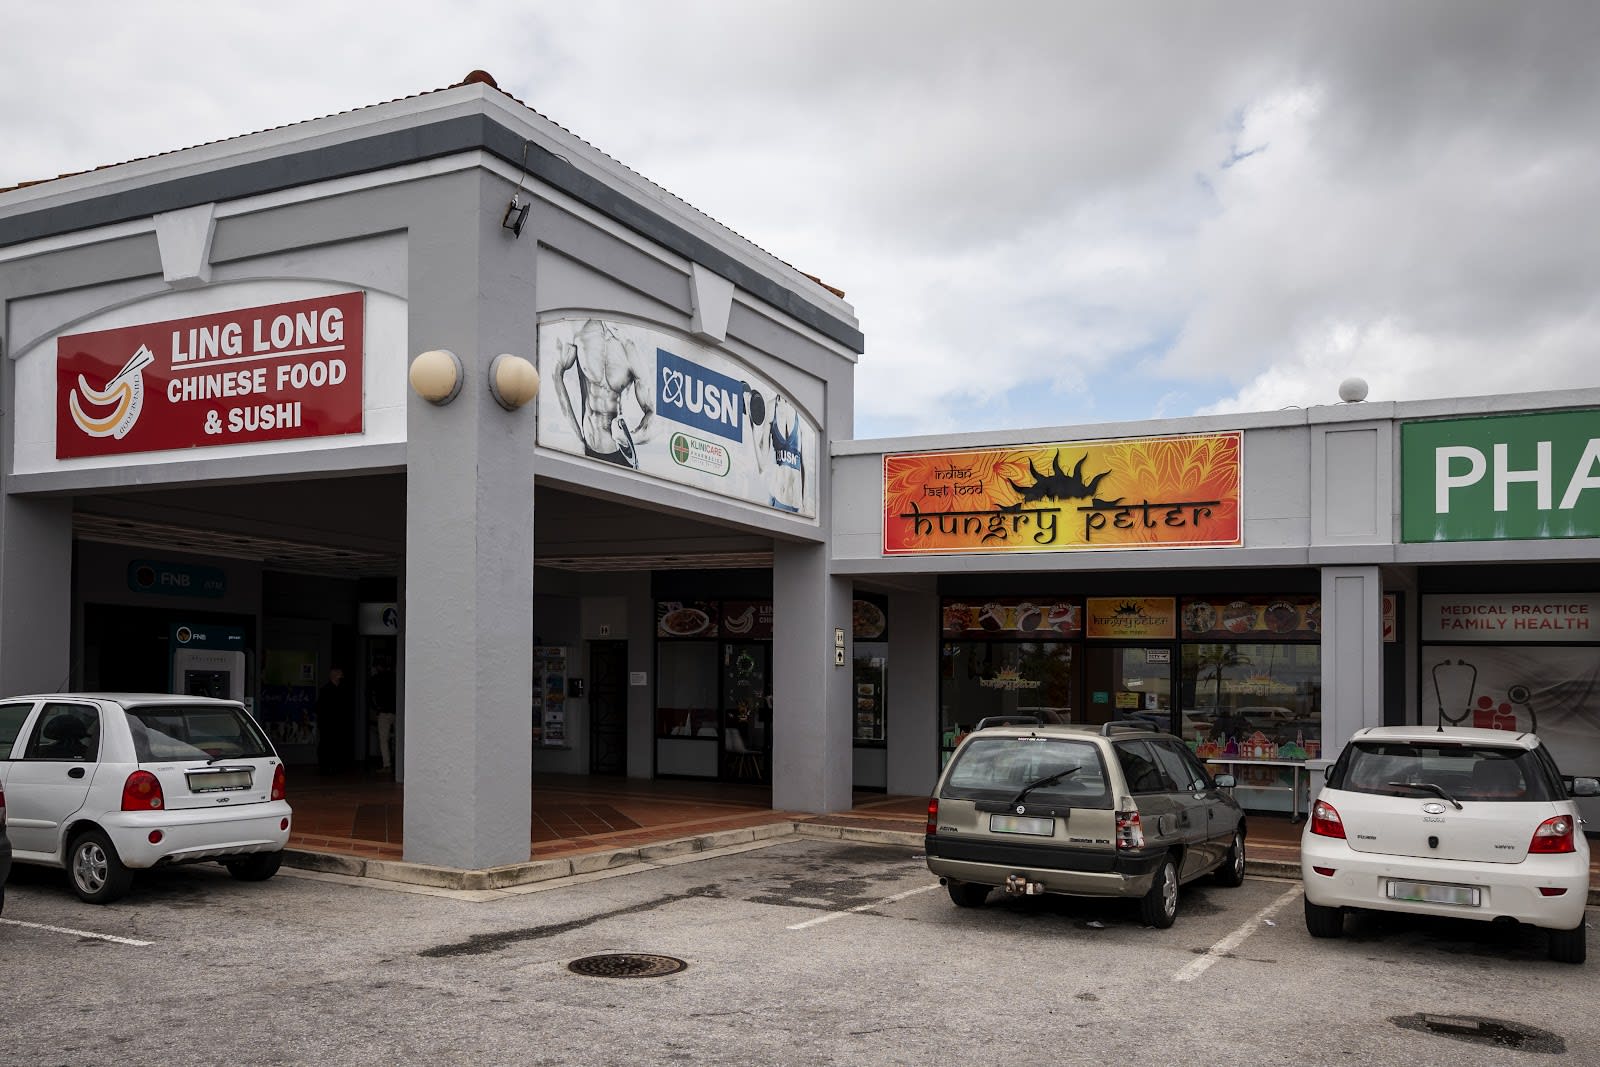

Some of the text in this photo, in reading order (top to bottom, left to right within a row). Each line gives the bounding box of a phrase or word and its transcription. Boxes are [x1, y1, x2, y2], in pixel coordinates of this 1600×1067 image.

[171, 307, 344, 363] LING LONG
[167, 359, 347, 403] CHINESE FOOD
[685, 375, 738, 428] USN
[204, 402, 302, 434] & SUSHI
[780, 450, 797, 465] USN
[934, 464, 972, 480] indian
[1435, 438, 1600, 513] PHA
[923, 480, 983, 497] fast food
[901, 498, 1220, 544] hungry peter
[160, 572, 191, 587] FNB
[759, 605, 773, 614] LIN
[1440, 604, 1589, 615] MEDICAL PRACTICE
[1440, 618, 1589, 630] FAMILY HEALTH
